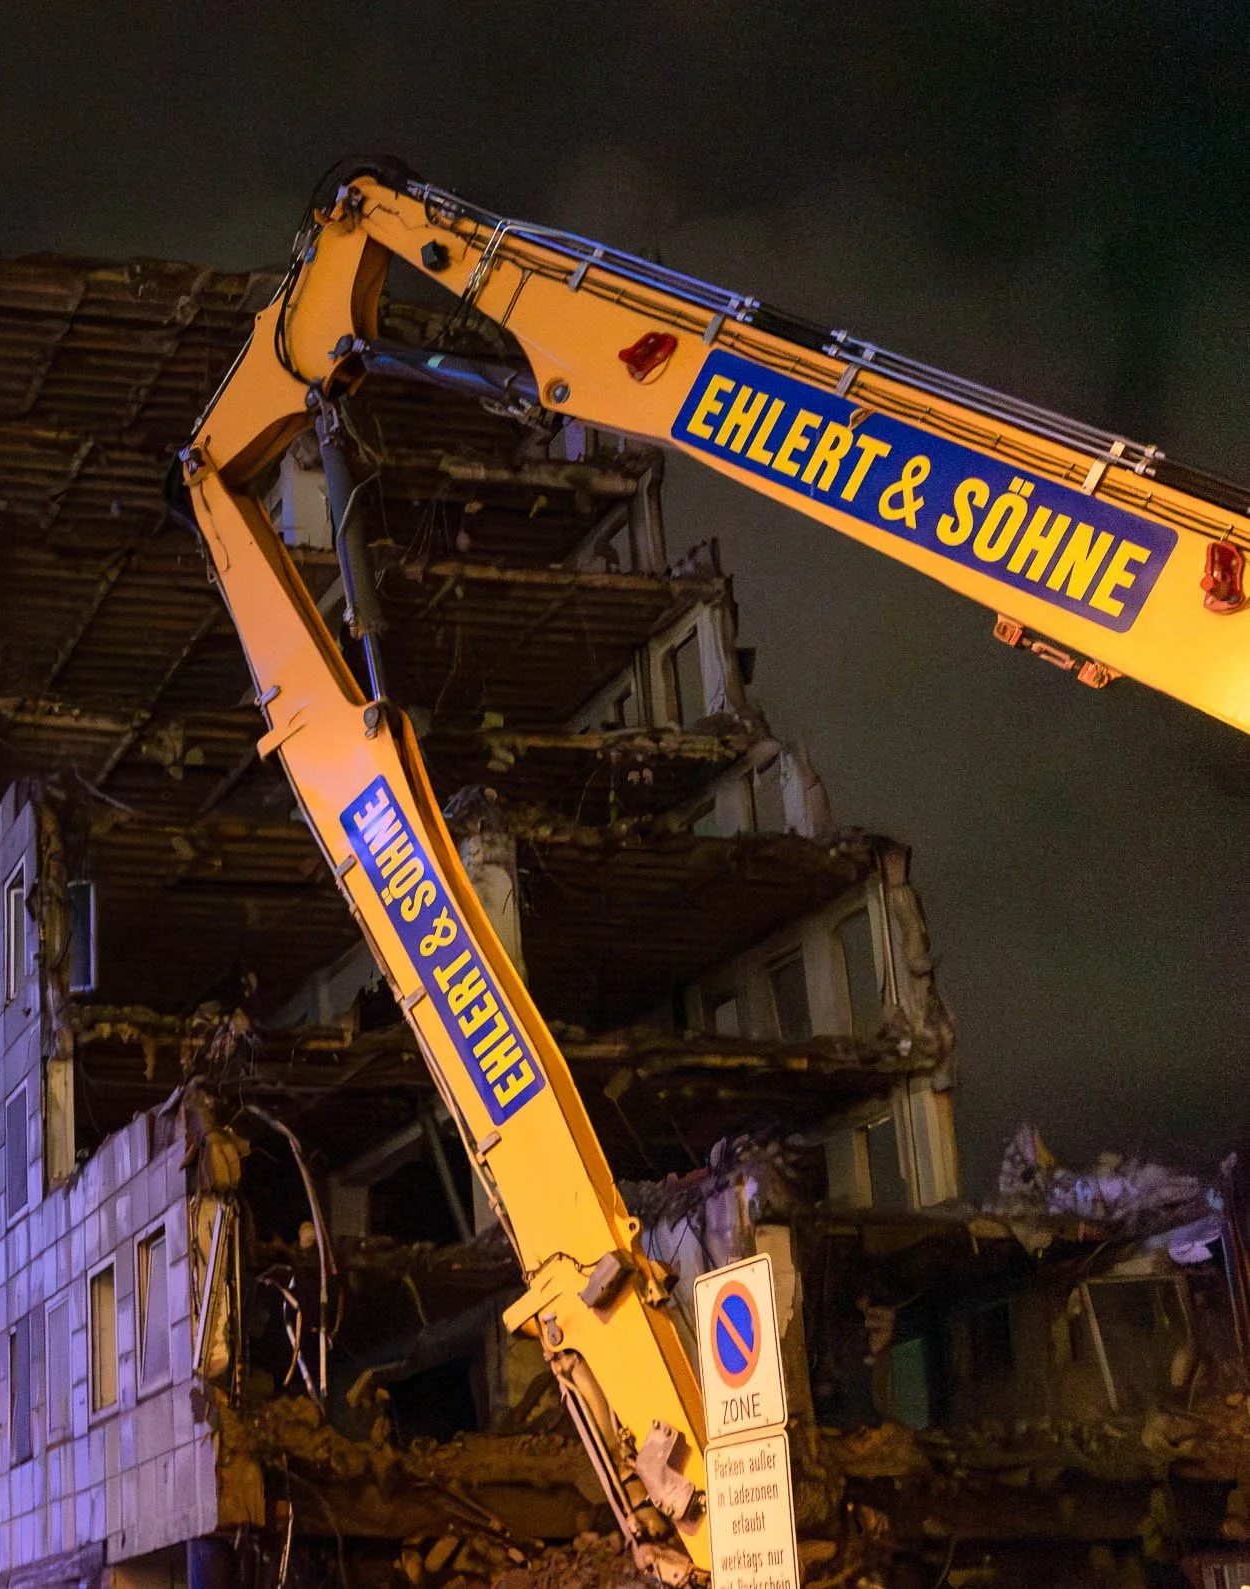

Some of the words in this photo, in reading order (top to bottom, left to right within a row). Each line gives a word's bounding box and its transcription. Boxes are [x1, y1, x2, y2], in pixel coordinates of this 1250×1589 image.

[686, 374, 894, 503] EHLERT
[878, 455, 931, 530] &
[936, 477, 1151, 618] SÖHNE
[353, 786, 437, 922] SÖHNE
[419, 906, 458, 957] &
[433, 950, 536, 1108] EHLERT
[721, 1392, 762, 1425] ZONE
[714, 1456, 745, 1479] Parken
[749, 1450, 776, 1473] außer
[717, 1488, 726, 1508] in
[728, 1482, 779, 1507] Ladezonen
[732, 1511, 766, 1535] erlaubt
[721, 1549, 763, 1573] werktags
[768, 1549, 784, 1566] nur
